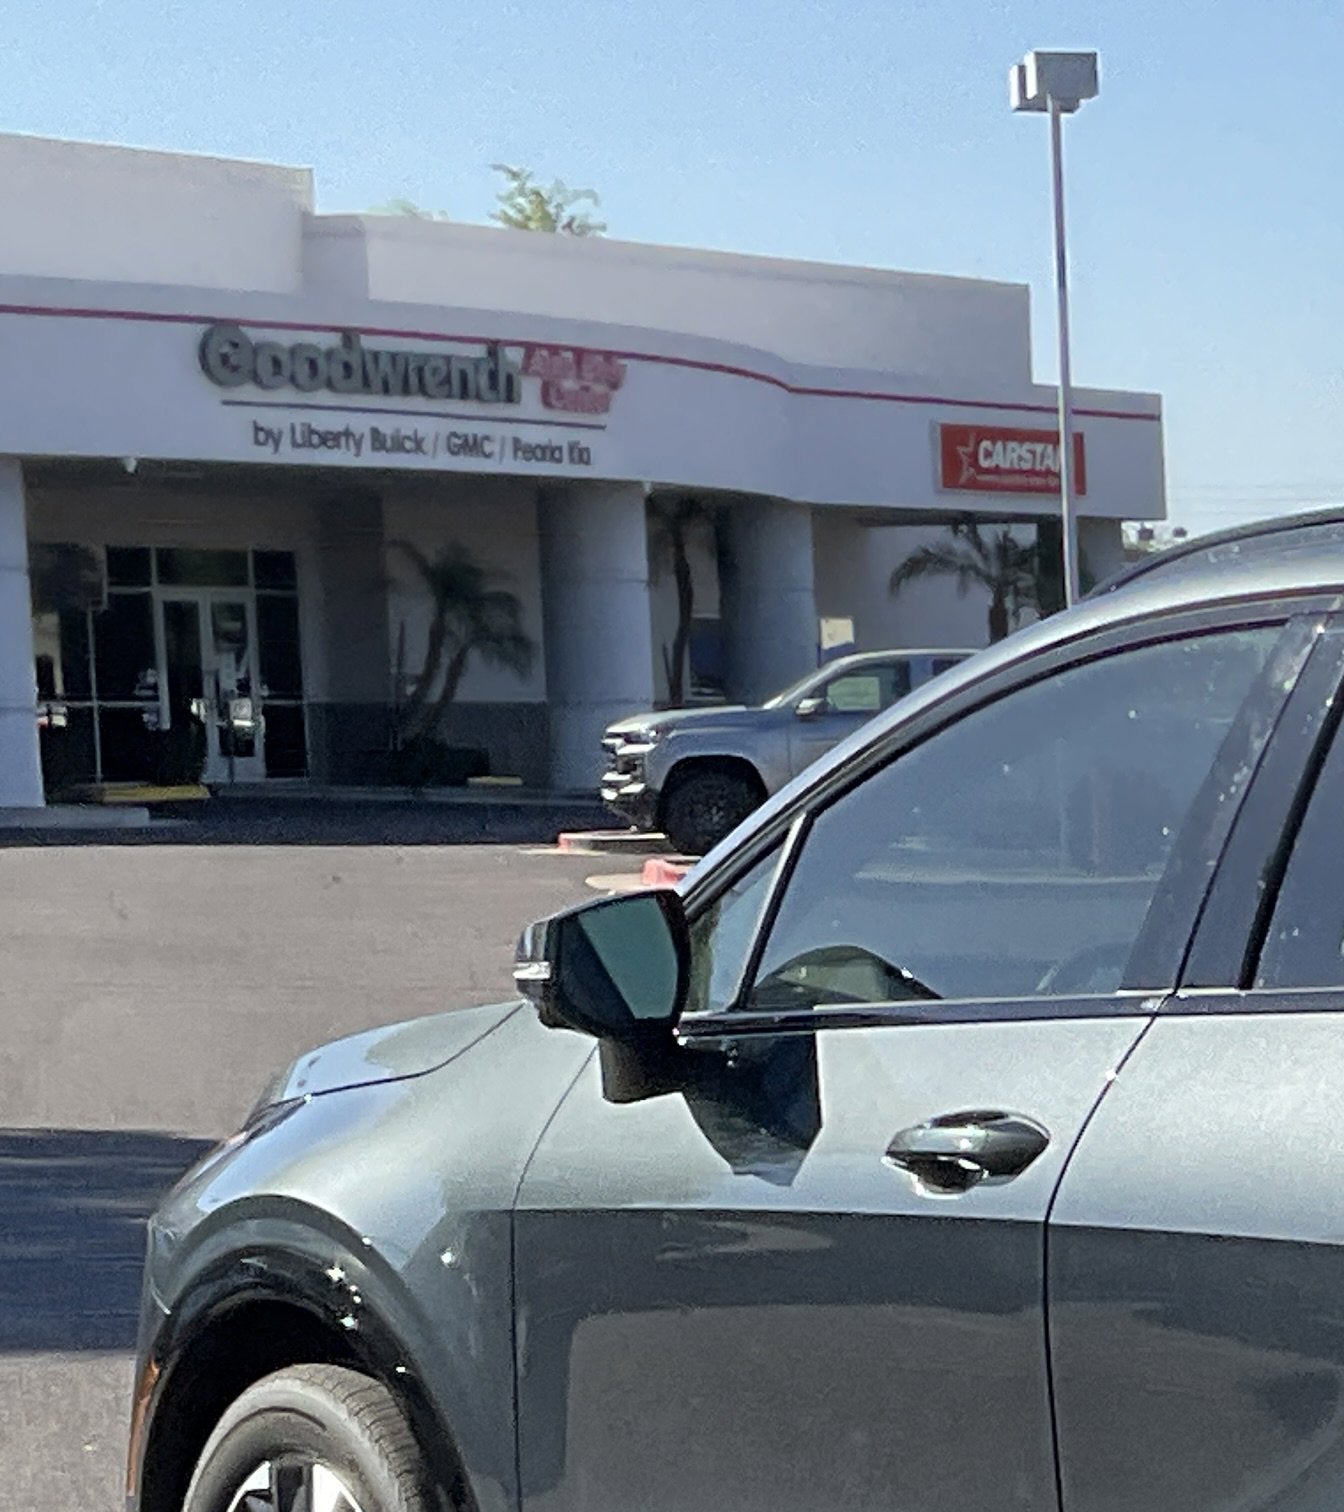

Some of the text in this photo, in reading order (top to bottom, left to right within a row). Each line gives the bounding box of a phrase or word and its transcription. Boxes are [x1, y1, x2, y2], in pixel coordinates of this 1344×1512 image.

[199, 319, 521, 404] Goodwrench
[252, 420, 283, 455] by
[290, 422, 364, 458] Liberty
[370, 426, 427, 456] Buick
[447, 431, 493, 459] GMC
[512, 436, 563, 464] Peoria
[568, 440, 592, 465] Kia
[977, 438, 1064, 473] CARSTA
